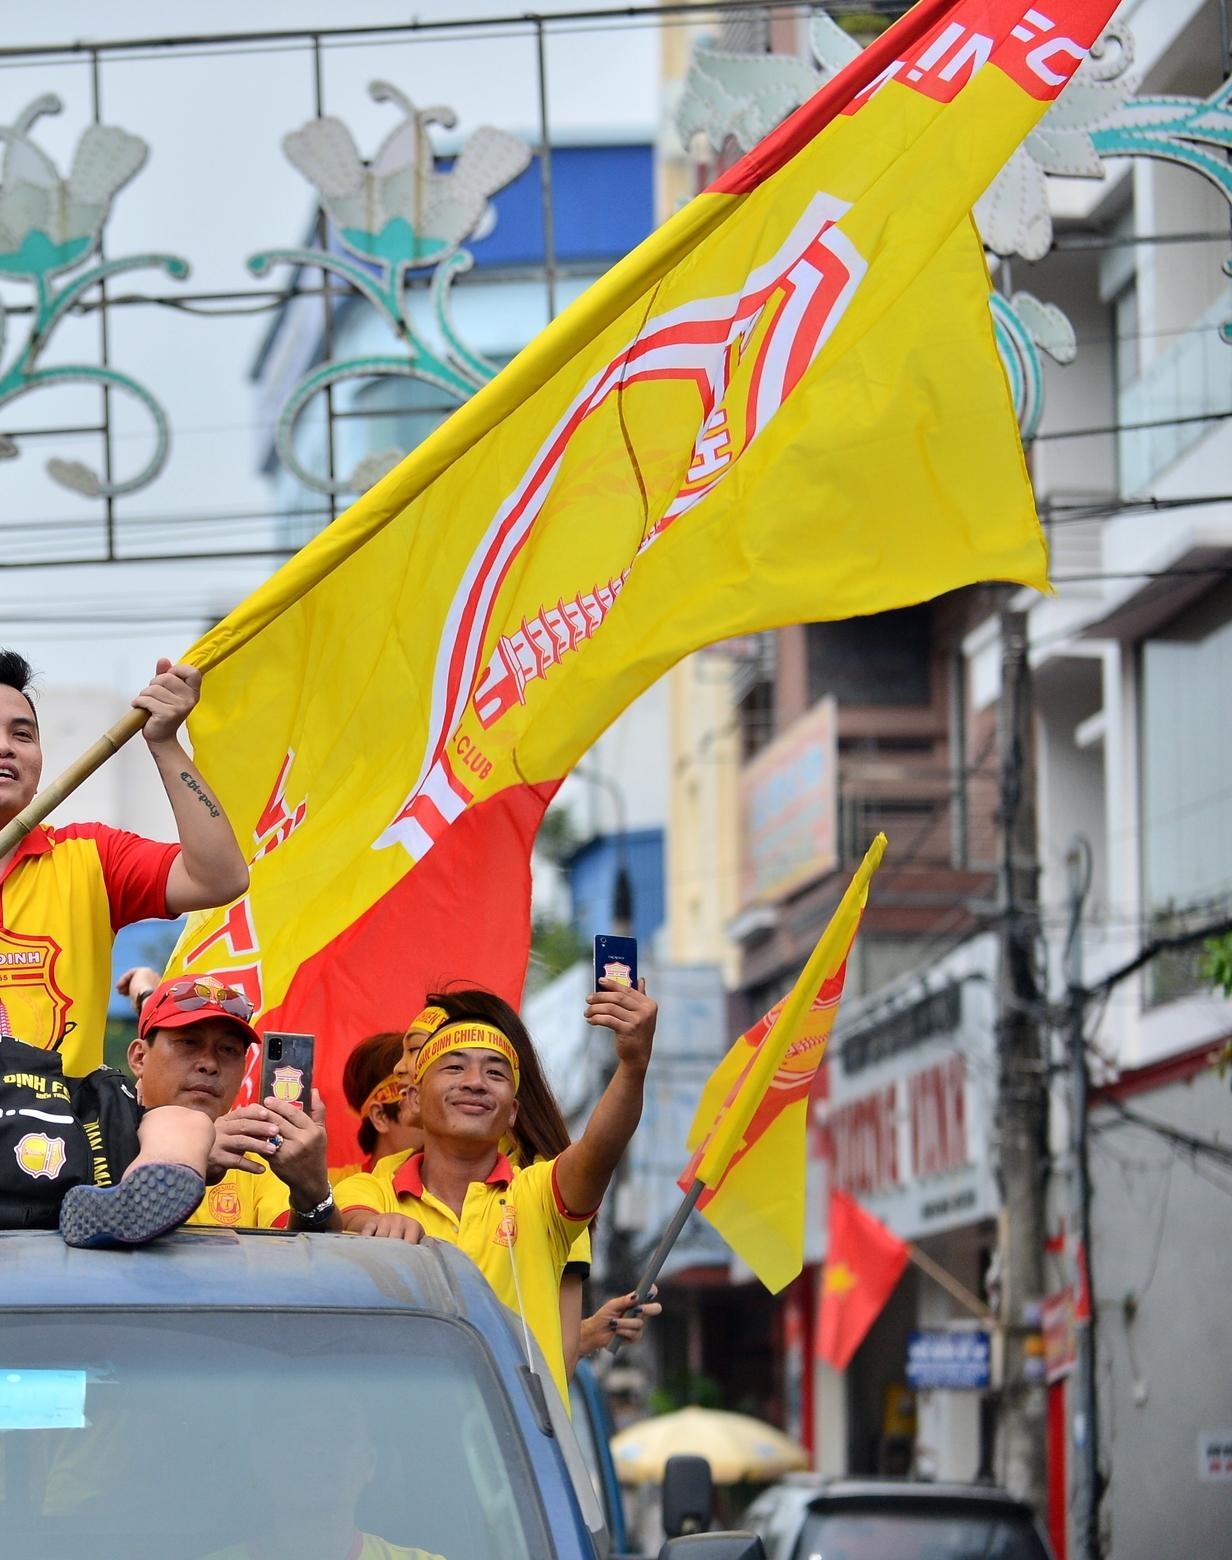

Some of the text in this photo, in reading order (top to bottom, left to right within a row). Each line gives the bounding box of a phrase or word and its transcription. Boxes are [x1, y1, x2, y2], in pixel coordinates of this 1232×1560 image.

[456, 735, 493, 780] CLUB
[454, 1026, 485, 1044] CHIẾN
[3, 1073, 46, 1093] ĐỊNH
